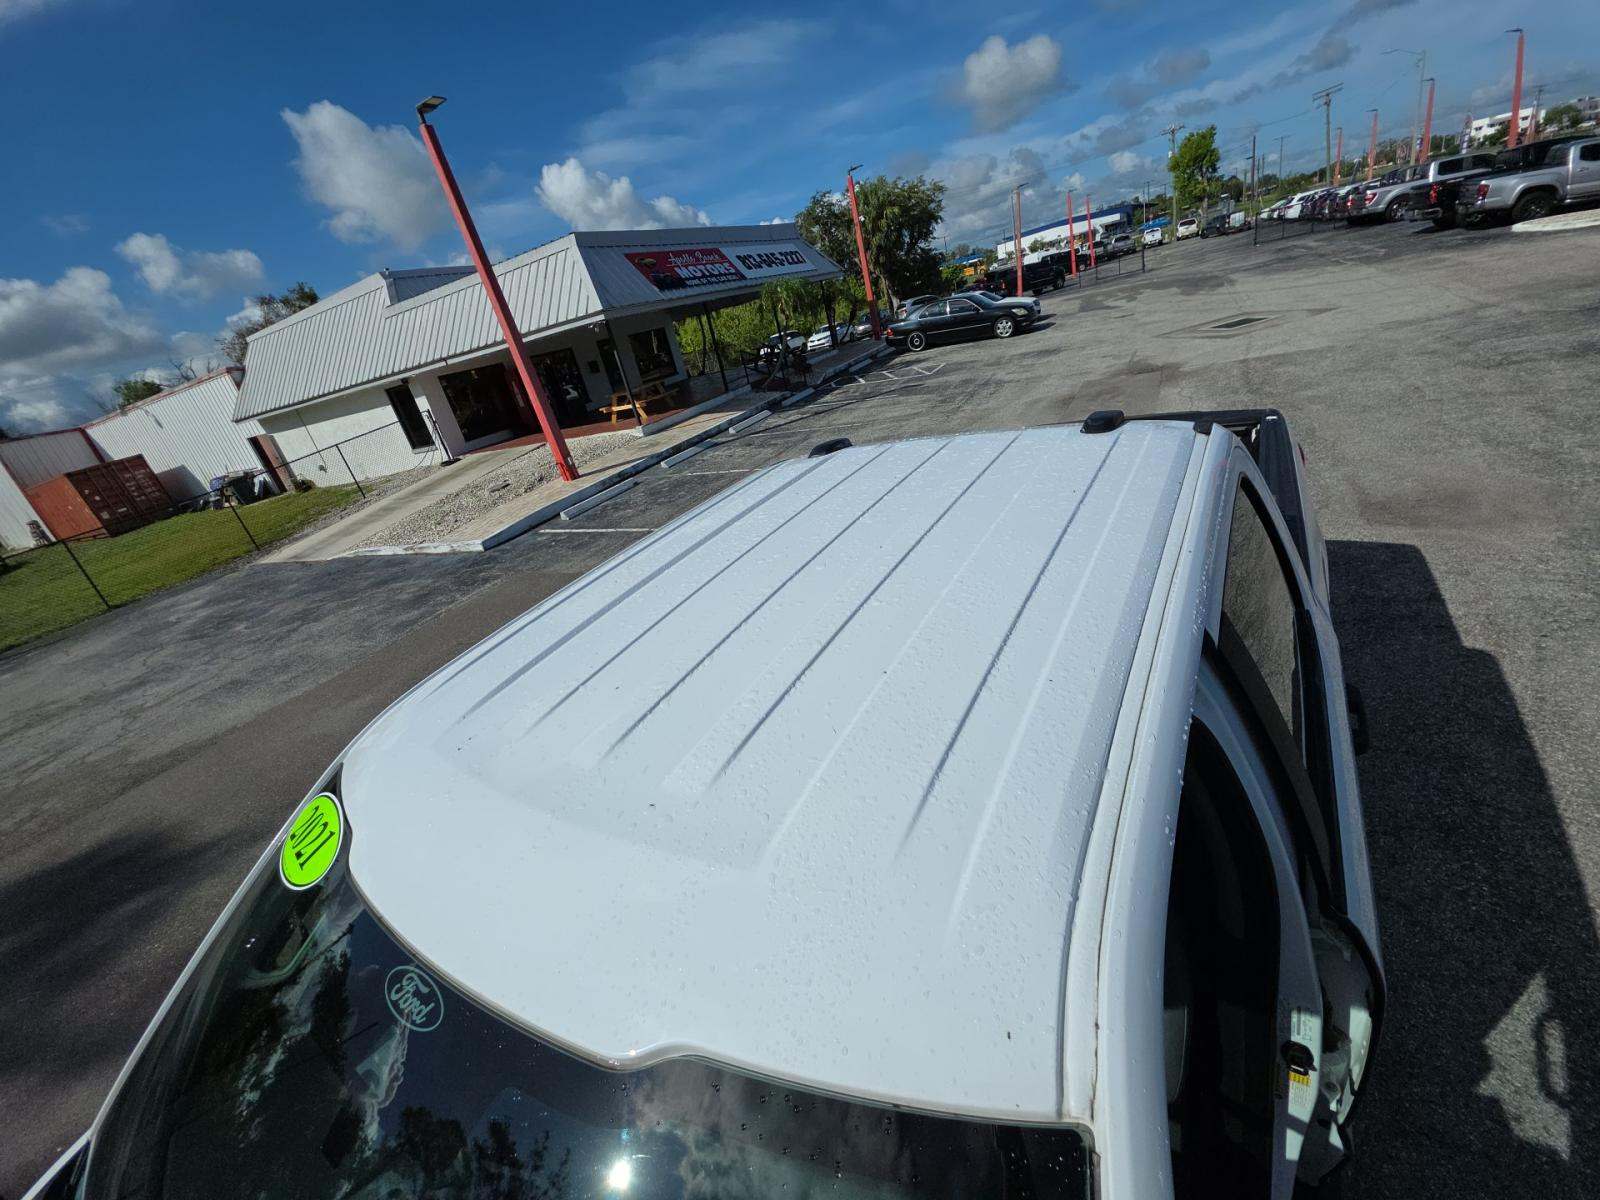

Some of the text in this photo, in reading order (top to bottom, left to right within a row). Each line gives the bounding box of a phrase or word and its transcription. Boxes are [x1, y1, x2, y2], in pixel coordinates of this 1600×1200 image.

[674, 262, 736, 279] MOTORS
[736, 250, 807, 270] 813-645-2227
[290, 805, 335, 870] 2021
[391, 972, 435, 1024] Ford
